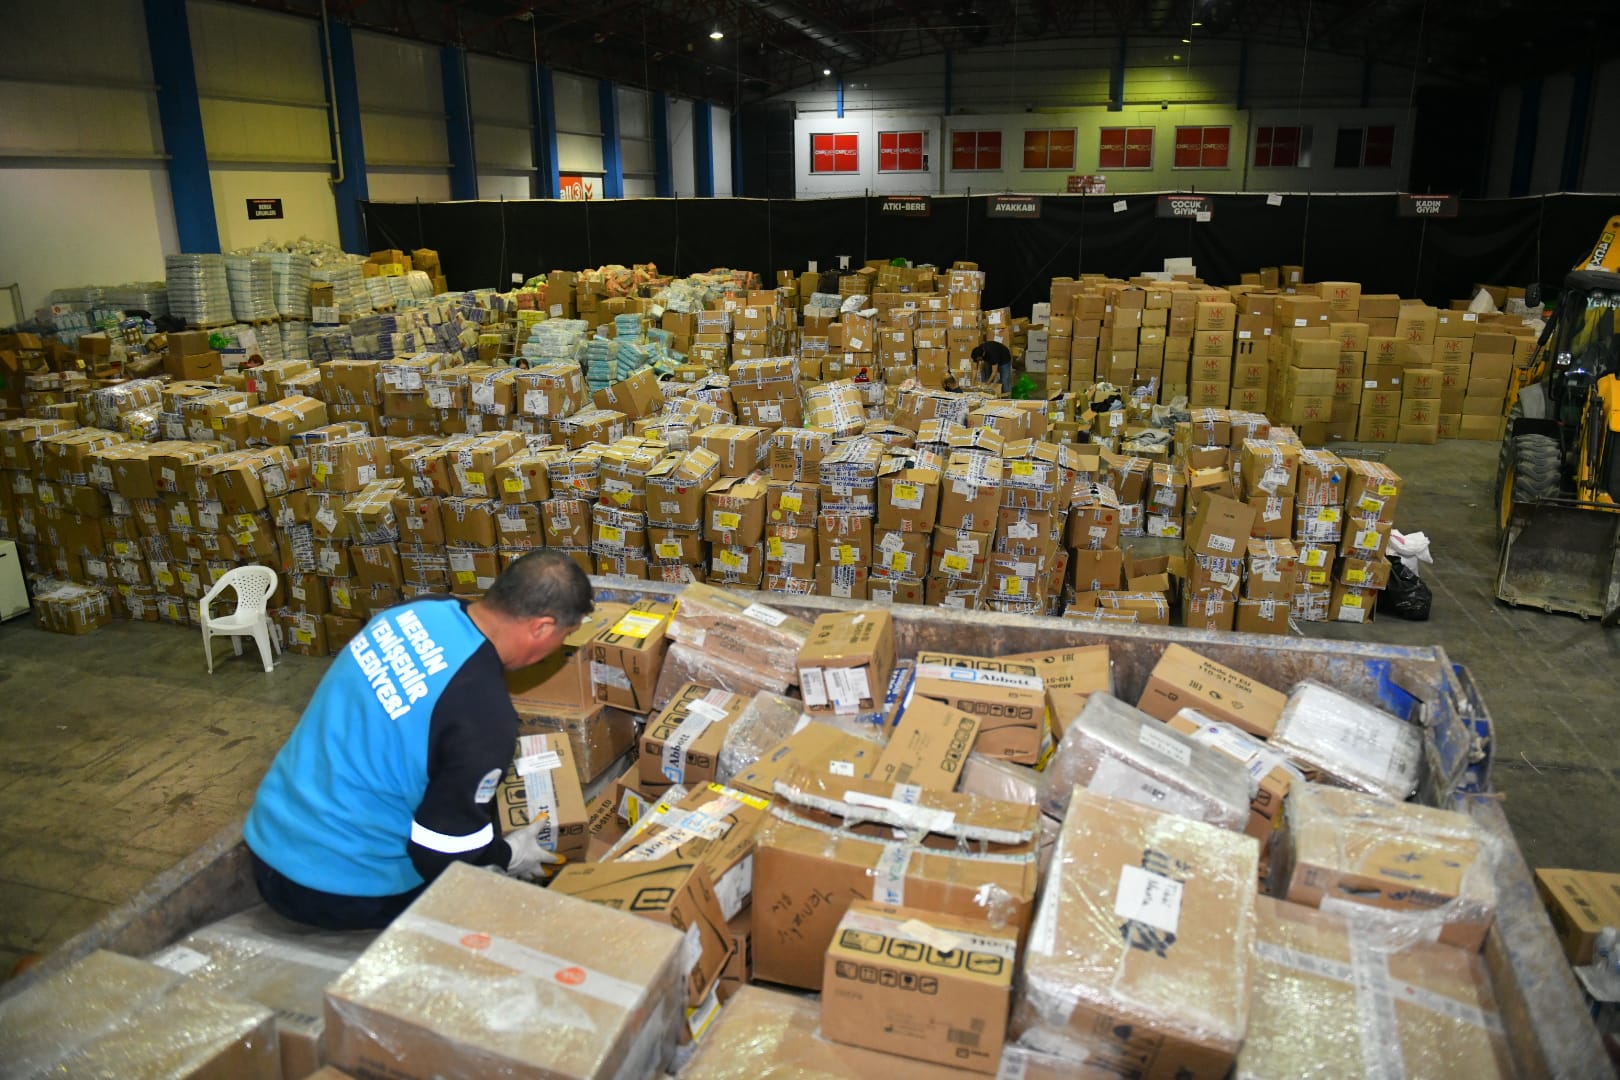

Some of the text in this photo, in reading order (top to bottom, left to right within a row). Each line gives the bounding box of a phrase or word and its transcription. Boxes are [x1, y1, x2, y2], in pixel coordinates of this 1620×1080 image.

[883, 203, 926, 211] ATKI-BERE
[995, 203, 1036, 211] AYAKKABI
[980, 673, 1030, 686] Abbott
[671, 734, 690, 767] Abbott
